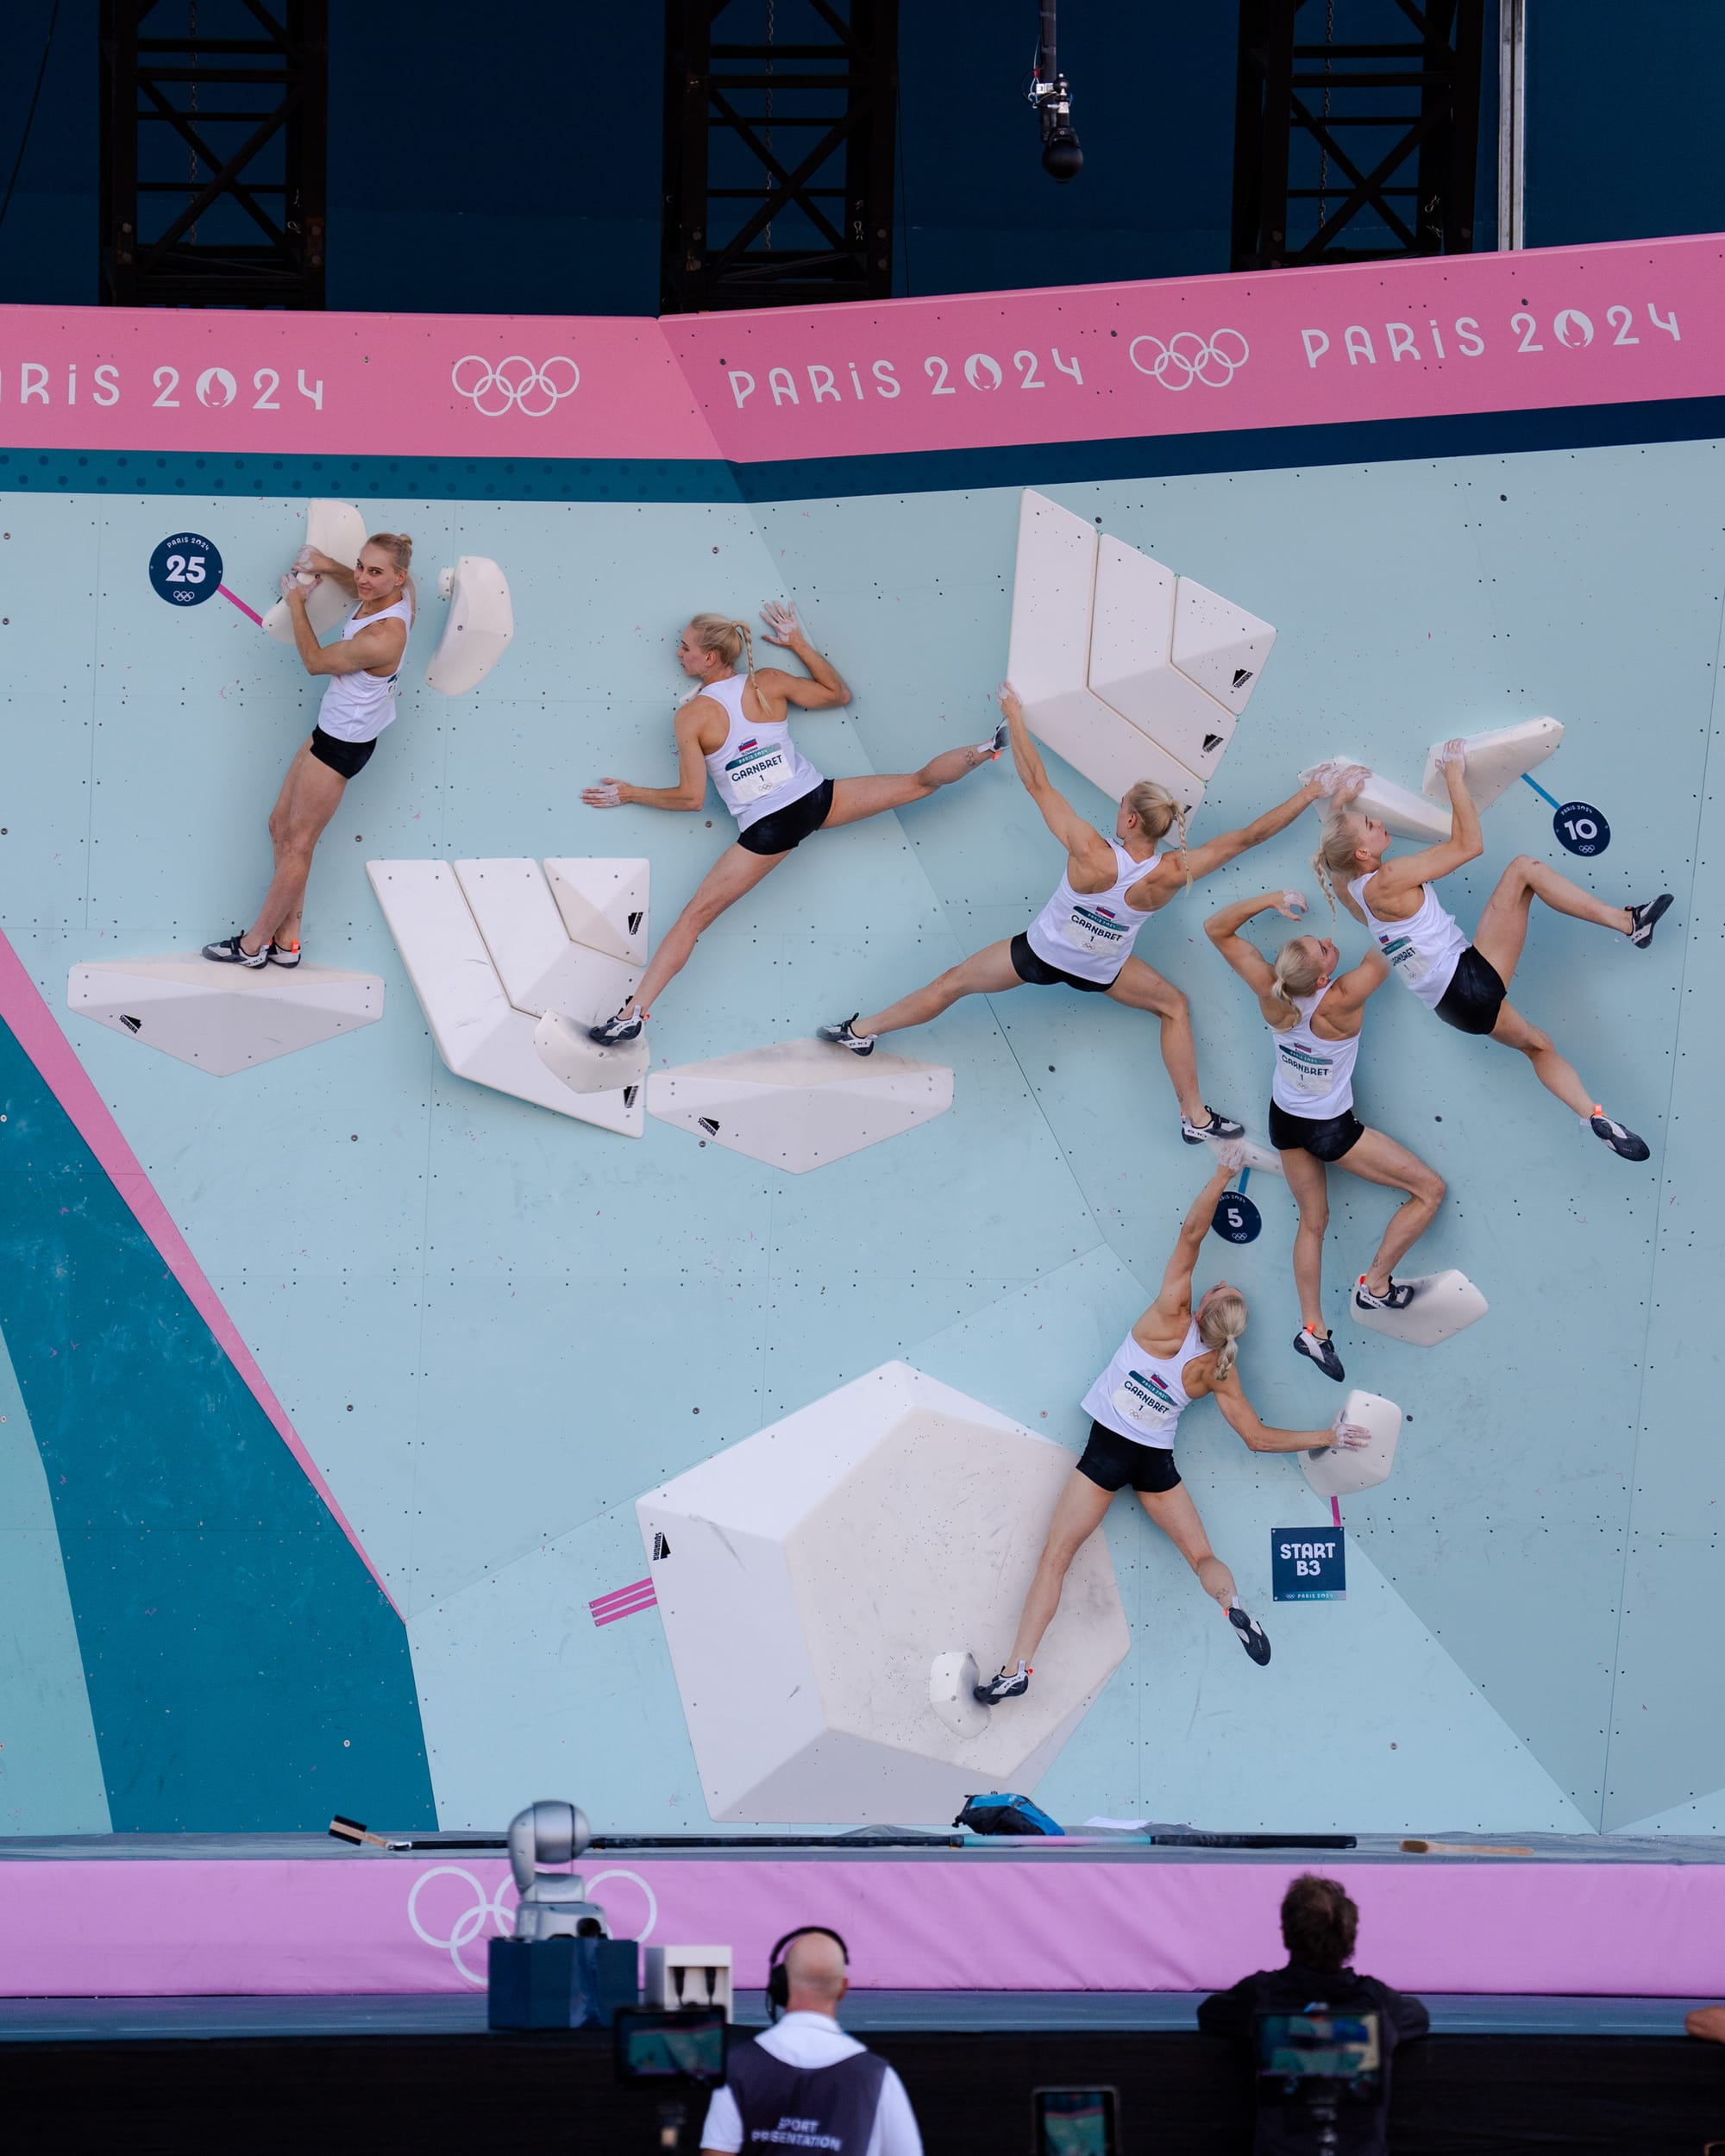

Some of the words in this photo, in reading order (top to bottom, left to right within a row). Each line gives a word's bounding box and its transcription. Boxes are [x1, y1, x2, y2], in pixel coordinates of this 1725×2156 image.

[1510, 303, 1681, 353] 2024
[924, 348, 1083, 395] 2024
[154, 366, 323, 410] 2024
[165, 555, 206, 584] 25
[731, 755, 782, 782] GARNBRET
[1564, 818, 1597, 840] 10
[1070, 914, 1123, 942] GARNBRET
[1227, 1208, 1243, 1228] 5
[1124, 1381, 1170, 1414] GARNBRET
[1280, 1542, 1336, 1559] START
[1296, 1560, 1320, 1576] B3
[777, 2117, 819, 2133] SPORT
